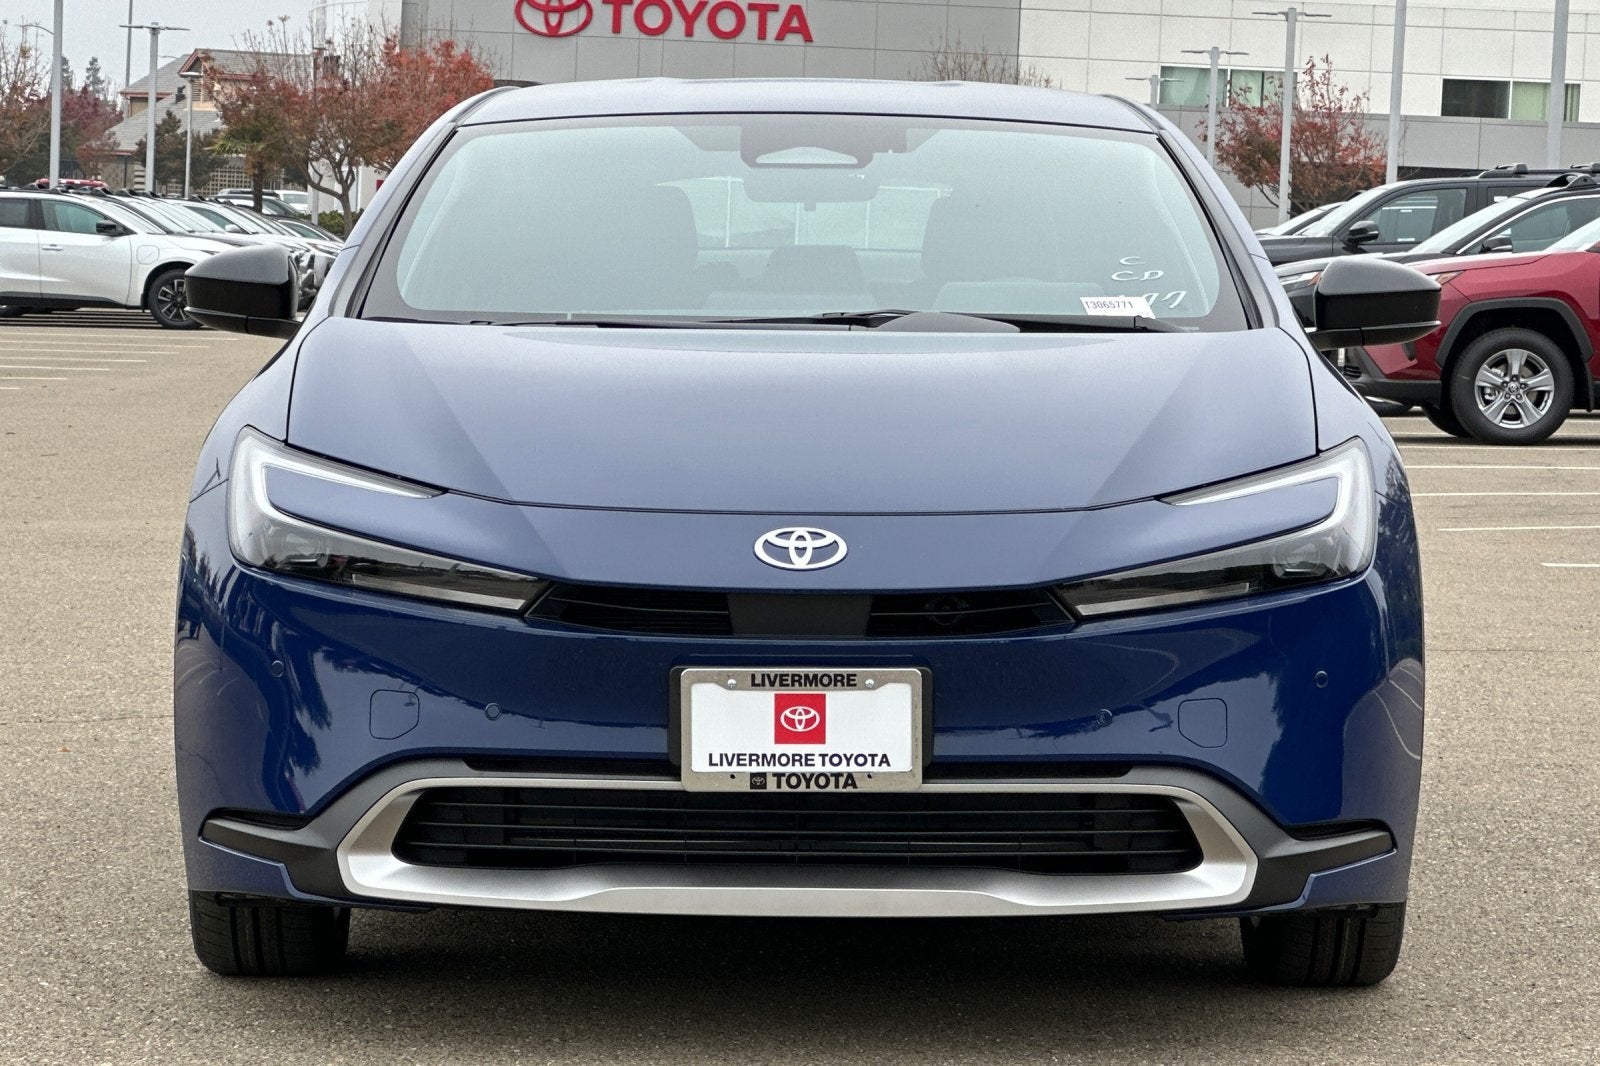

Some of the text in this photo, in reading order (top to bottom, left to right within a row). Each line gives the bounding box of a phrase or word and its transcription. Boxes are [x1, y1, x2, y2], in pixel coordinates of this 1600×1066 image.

[601, 0, 814, 42] TOYOTA
[750, 673, 858, 688] LIVERMORE
[708, 753, 891, 767] LIVERMORE TOYOTA
[772, 772, 858, 790] TOYOTA
